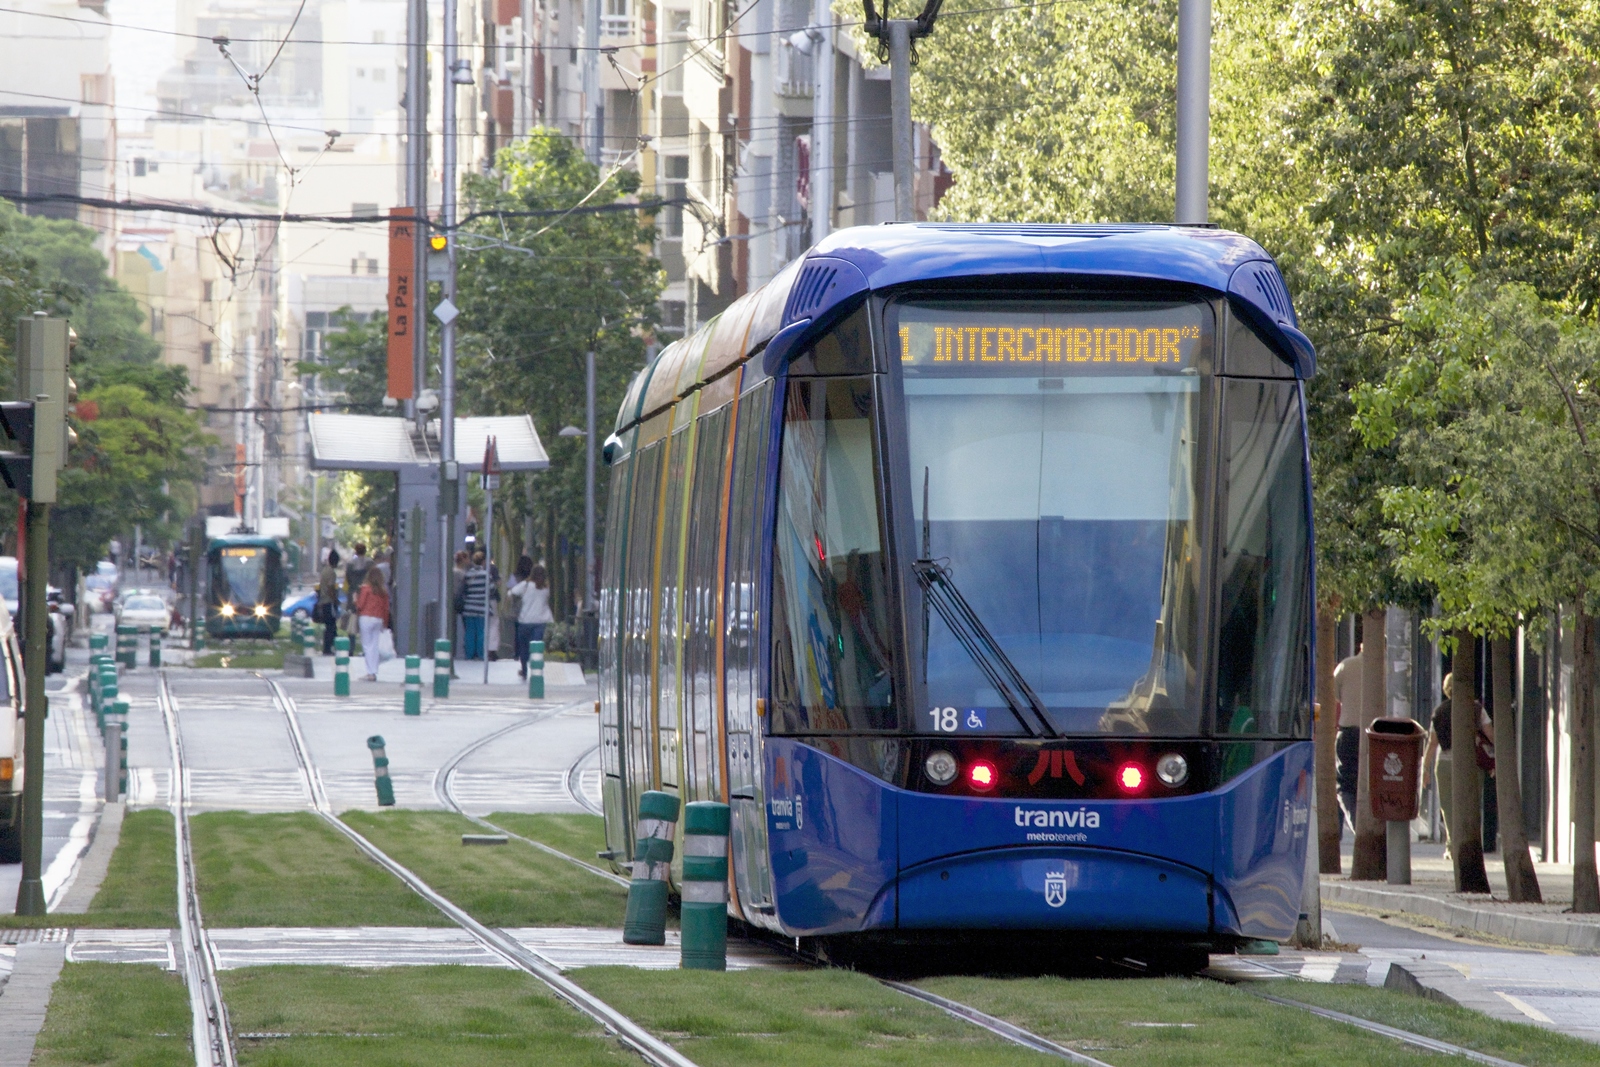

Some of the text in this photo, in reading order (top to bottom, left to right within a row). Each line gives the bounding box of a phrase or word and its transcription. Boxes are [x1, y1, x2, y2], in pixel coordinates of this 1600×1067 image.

[394, 275, 408, 336] La Paz
[898, 327, 914, 361] 1
[933, 326, 1180, 362] INTERCAMBIADOR
[929, 706, 958, 732] 18
[1014, 805, 1101, 829] tranvía
[1026, 831, 1088, 842] metrotenerife
